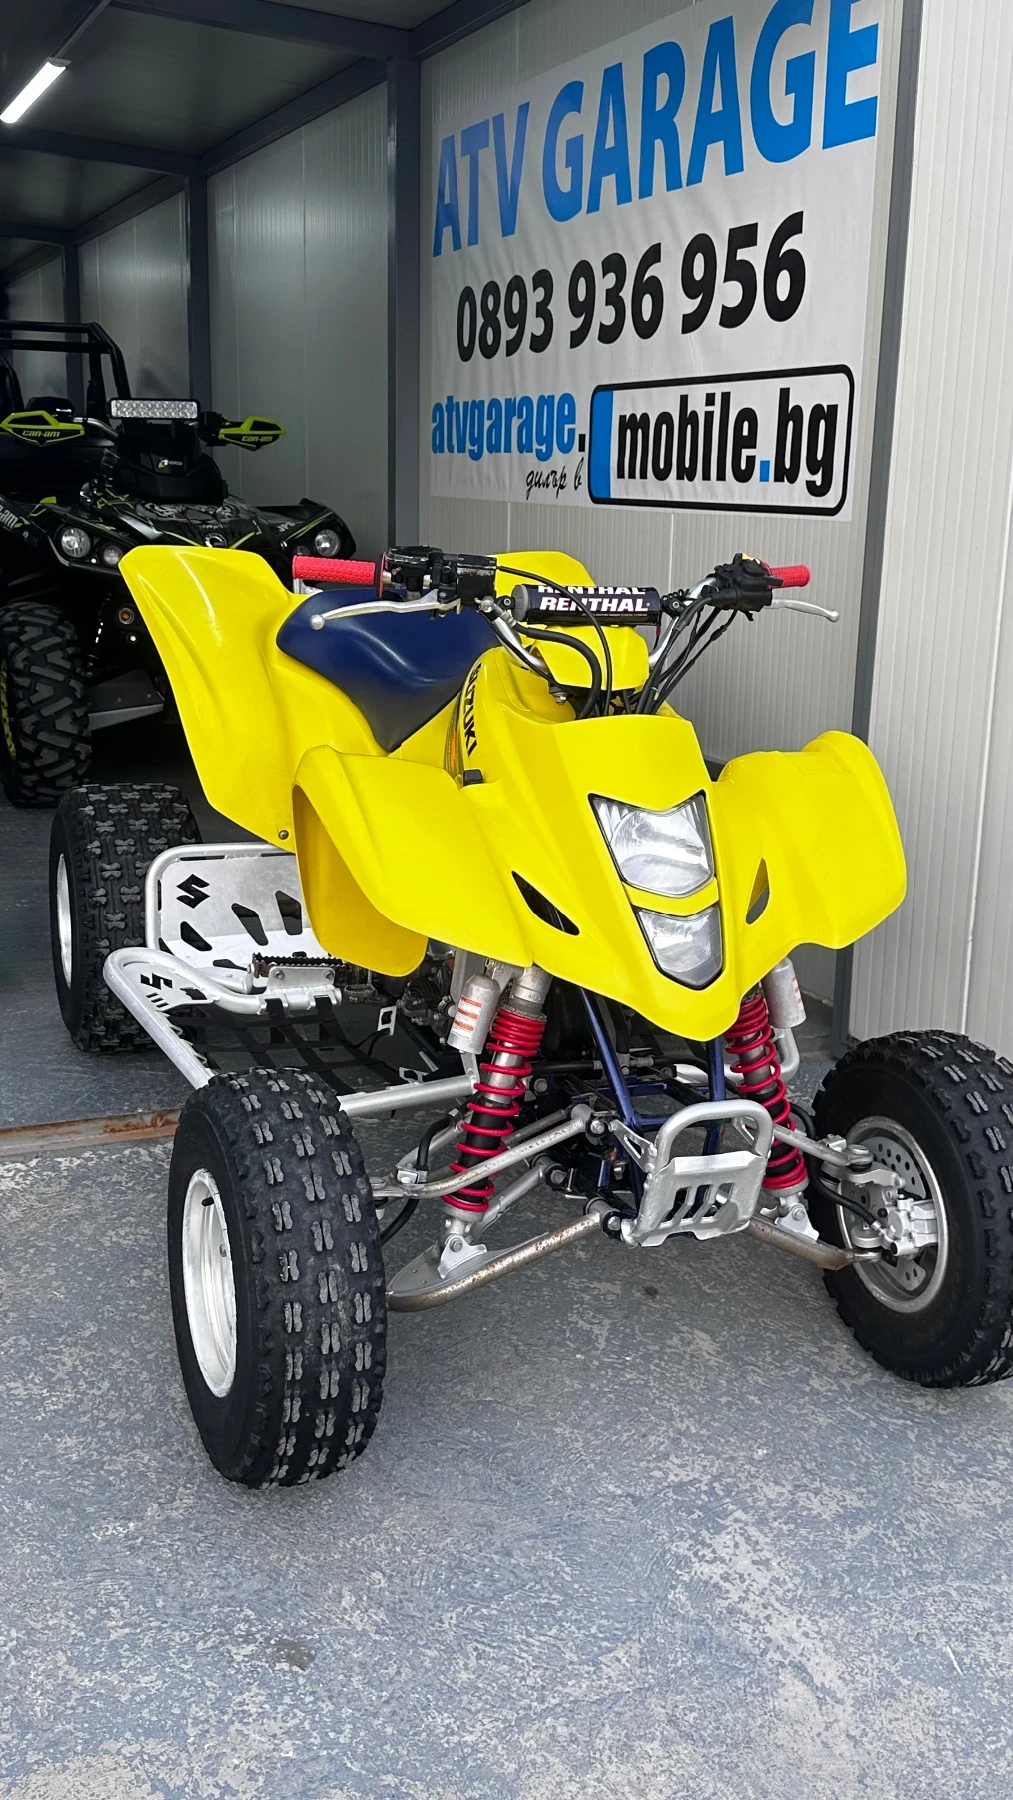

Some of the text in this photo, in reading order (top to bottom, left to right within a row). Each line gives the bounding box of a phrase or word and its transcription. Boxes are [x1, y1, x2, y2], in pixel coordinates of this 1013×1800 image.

[433, 0, 880, 258] ATV GARAGE
[456, 210, 807, 362] 0893 936 956
[616, 387, 839, 497] mobile.bg
[463, 662, 482, 759] SUZUKI
